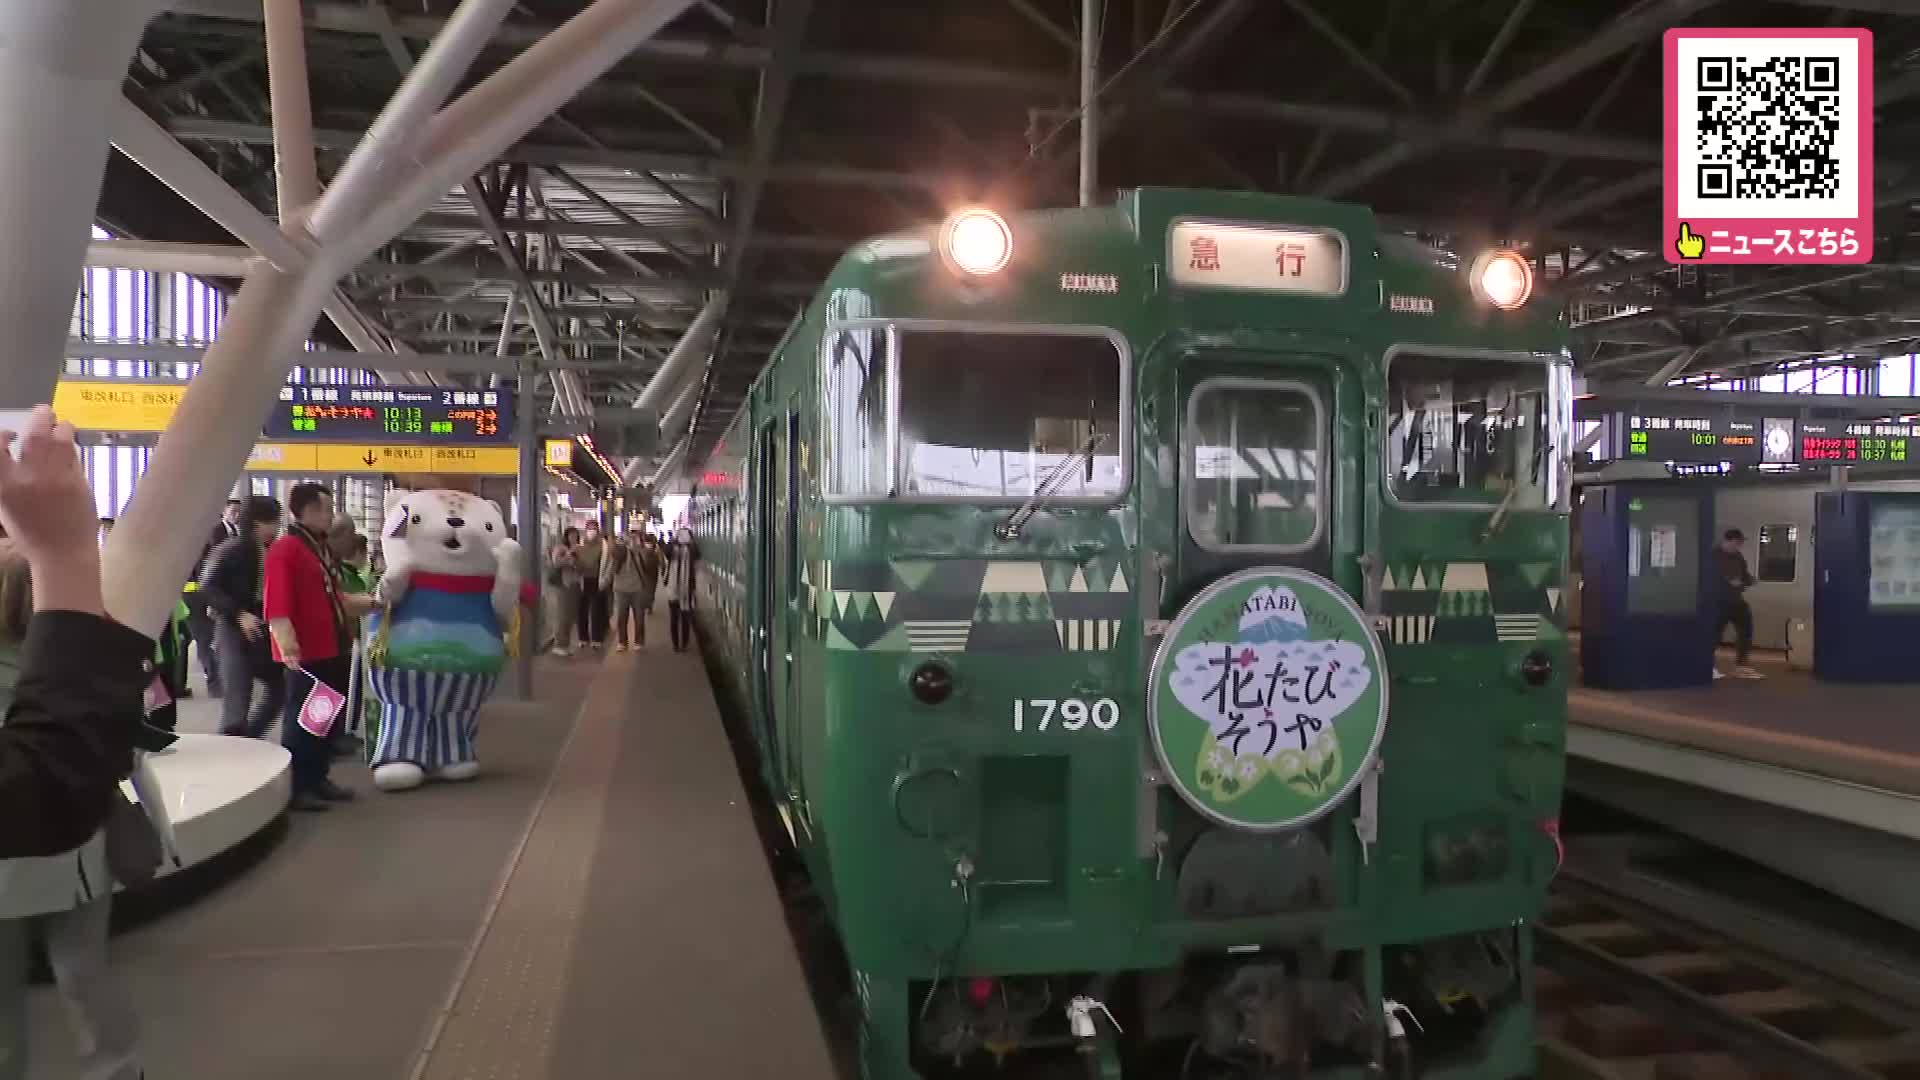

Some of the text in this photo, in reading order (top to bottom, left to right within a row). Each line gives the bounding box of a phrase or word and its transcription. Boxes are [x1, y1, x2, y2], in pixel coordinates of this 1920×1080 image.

[383, 407, 422, 420] 10:13
[383, 420, 422, 433] 10:39
[1692, 433, 1716, 445] 10:01
[1201, 645, 1341, 715] 花たび
[1013, 697, 1120, 731] 1790
[1215, 711, 1323, 757] そうや
